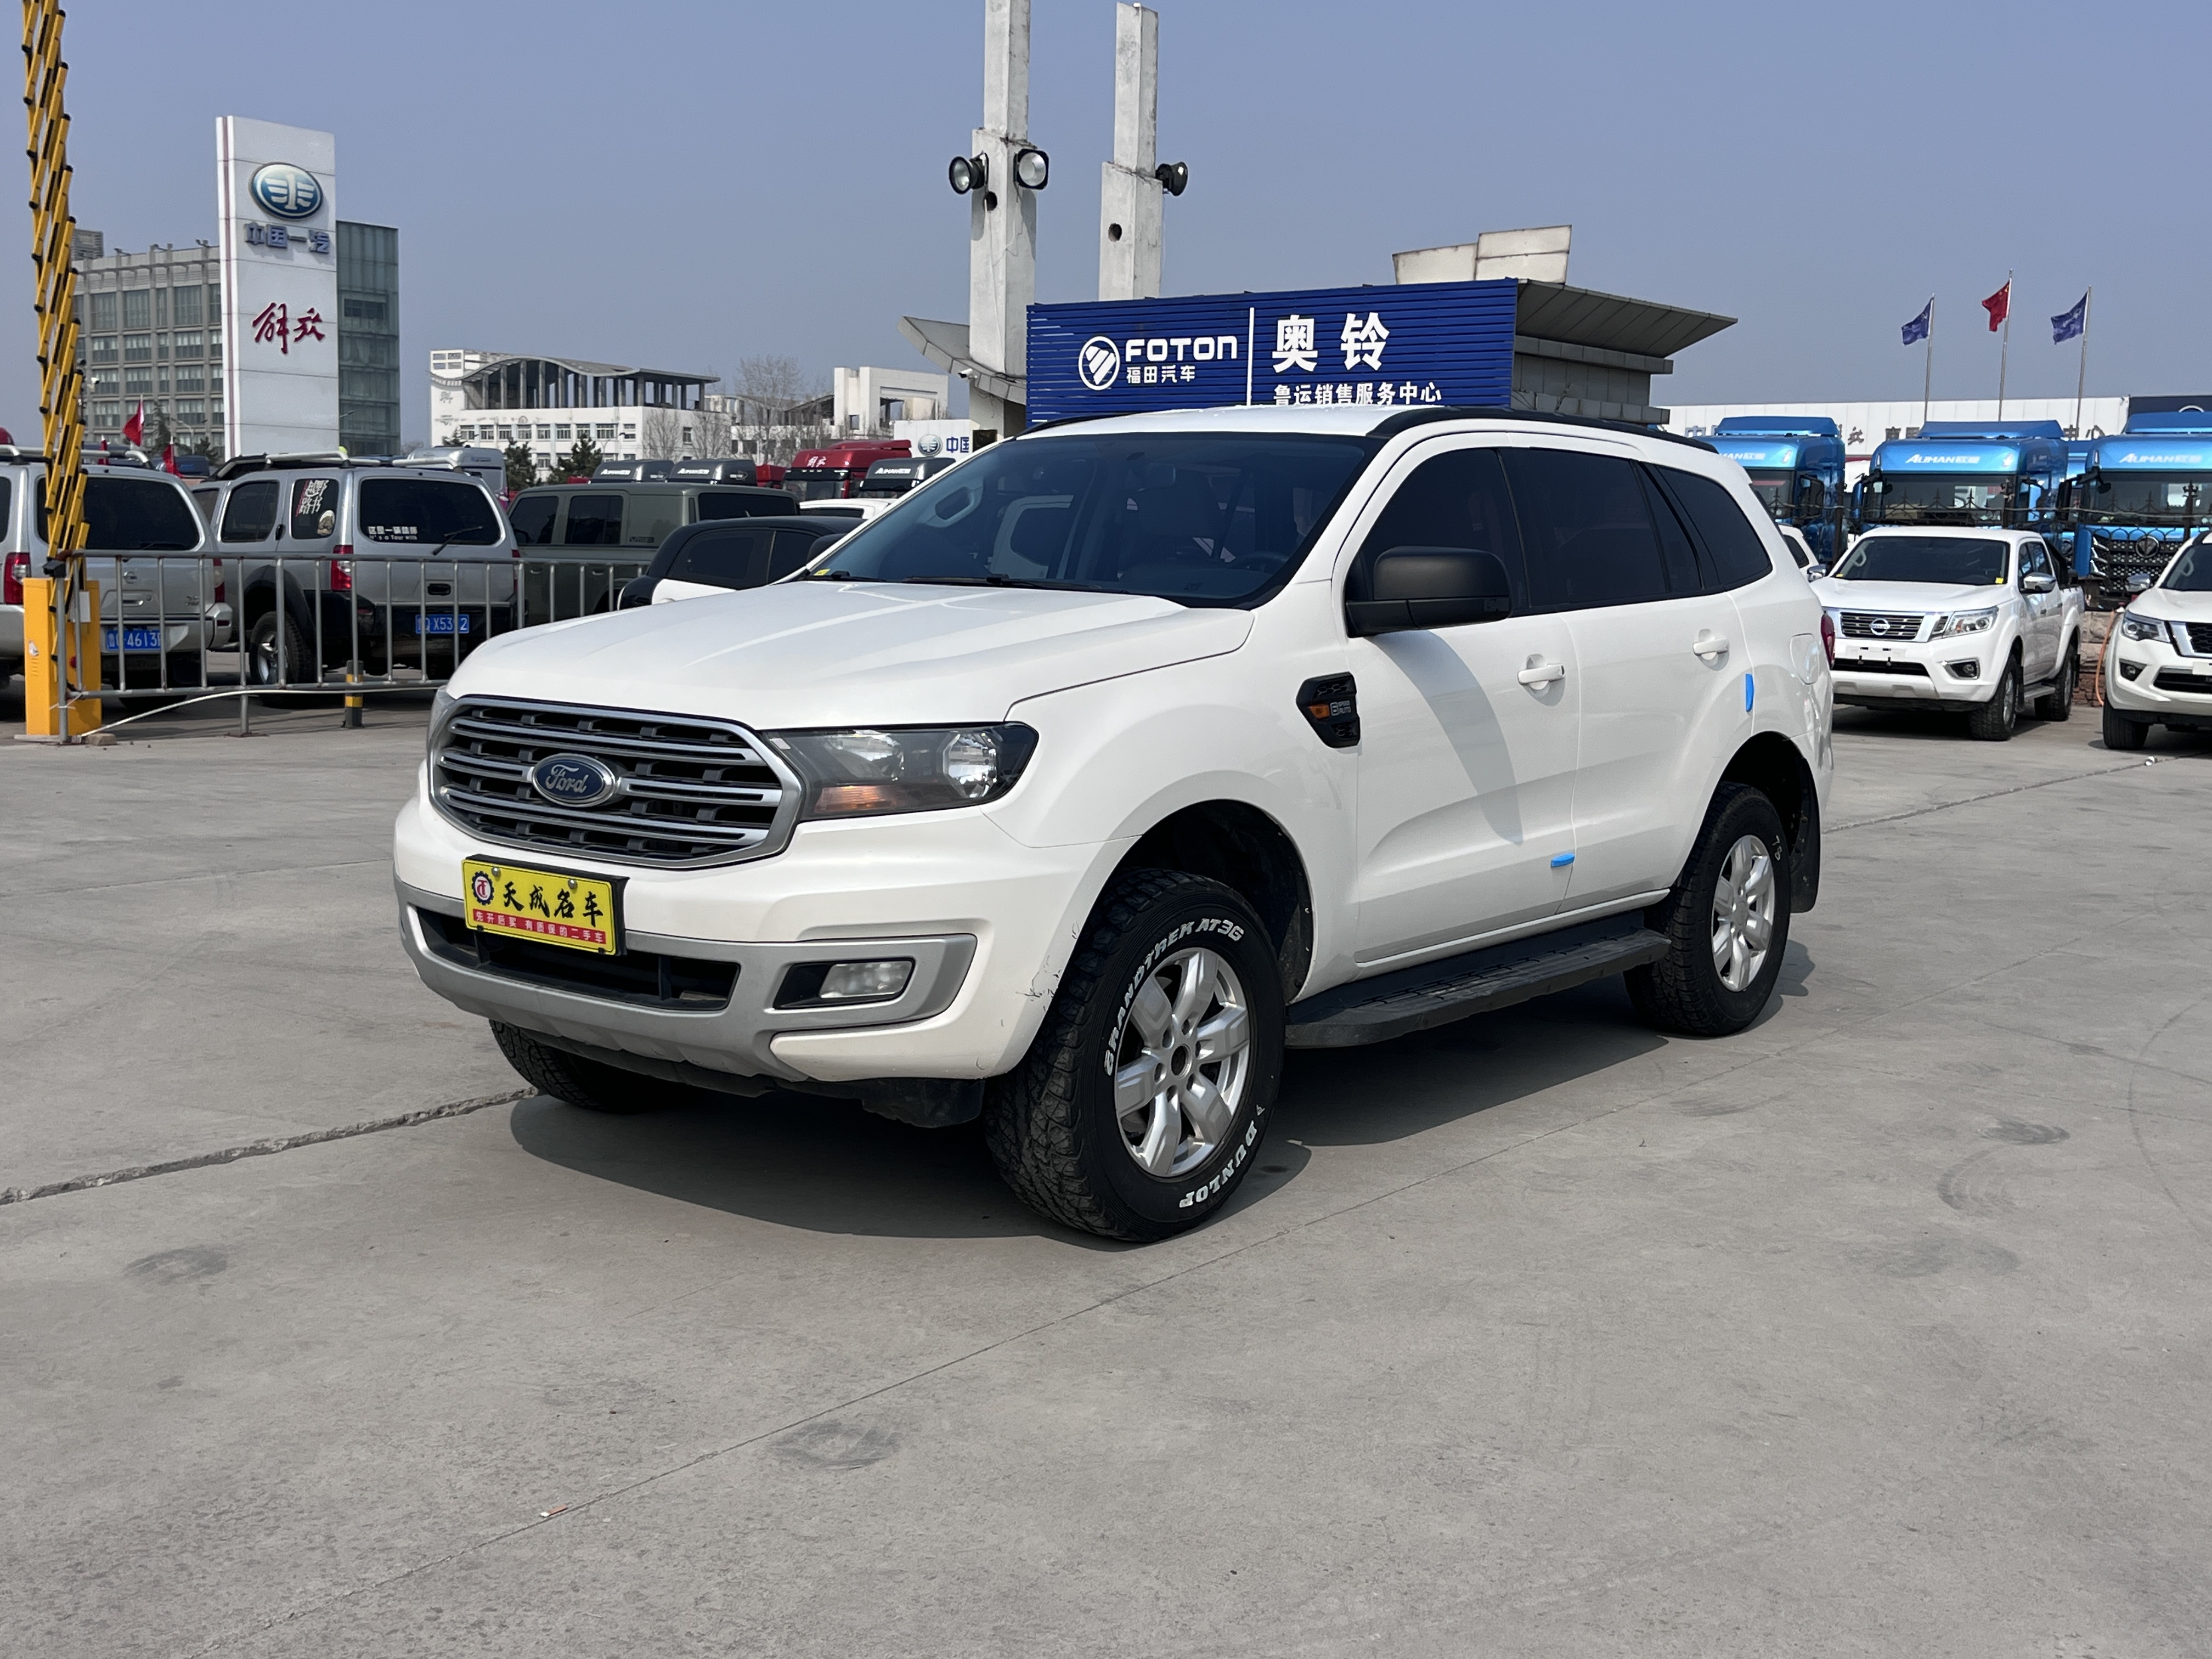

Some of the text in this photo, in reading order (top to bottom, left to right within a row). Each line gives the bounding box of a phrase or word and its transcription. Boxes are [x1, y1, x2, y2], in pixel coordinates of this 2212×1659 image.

[245, 222, 330, 254] 中国一汽
[252, 302, 325, 355] 解放
[1271, 312, 1390, 373] 奥铃
[1125, 336, 1238, 362] FOTON
[1126, 364, 1195, 383] 福田汽车
[1273, 381, 1442, 405] 鲁运销售服务中心
[946, 436, 969, 453] 中国
[545, 764, 589, 793] Ford
[503, 881, 603, 928] 天成名车
[476, 911, 603, 943] 先开后买 有质保的二手车
[1104, 921, 1195, 1077] GRANDTREK
[1179, 1120, 1257, 1208] DUNLOP
